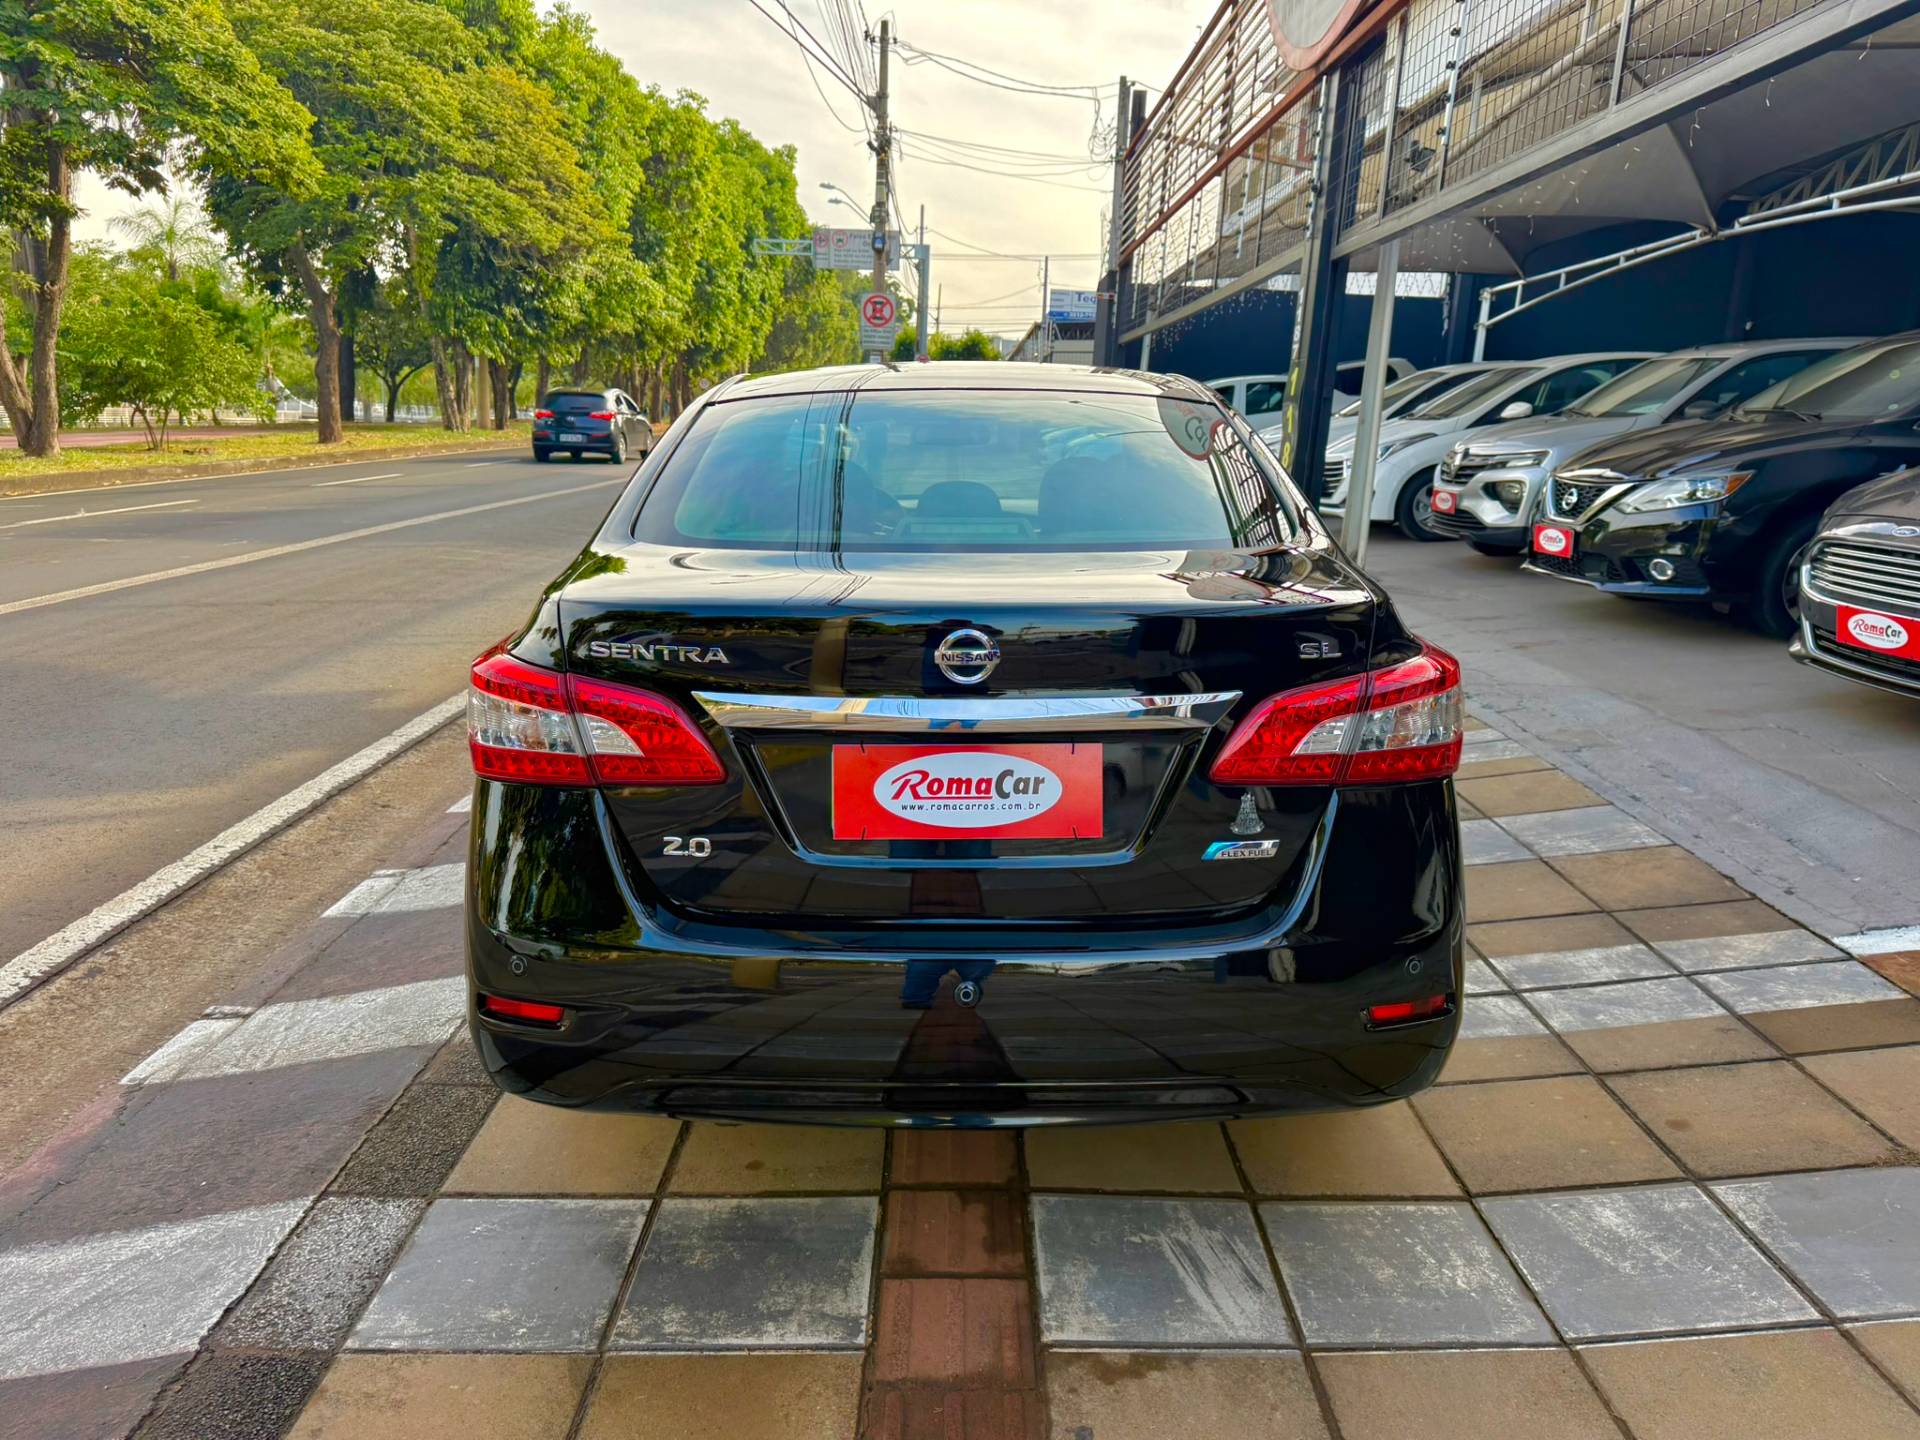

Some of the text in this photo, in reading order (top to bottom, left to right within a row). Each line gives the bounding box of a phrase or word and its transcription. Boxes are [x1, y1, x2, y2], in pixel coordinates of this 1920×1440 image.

[1853, 618, 1903, 639] RomaCar
[590, 640, 730, 664] SENTRA
[941, 652, 994, 662] NISSAN
[1300, 642, 1343, 659] SL
[891, 769, 1046, 800] RomaCar
[901, 801, 1041, 811] www.romacarros.com.br
[663, 836, 712, 858] 2.0
[1221, 848, 1273, 858] FLEX FUEL
